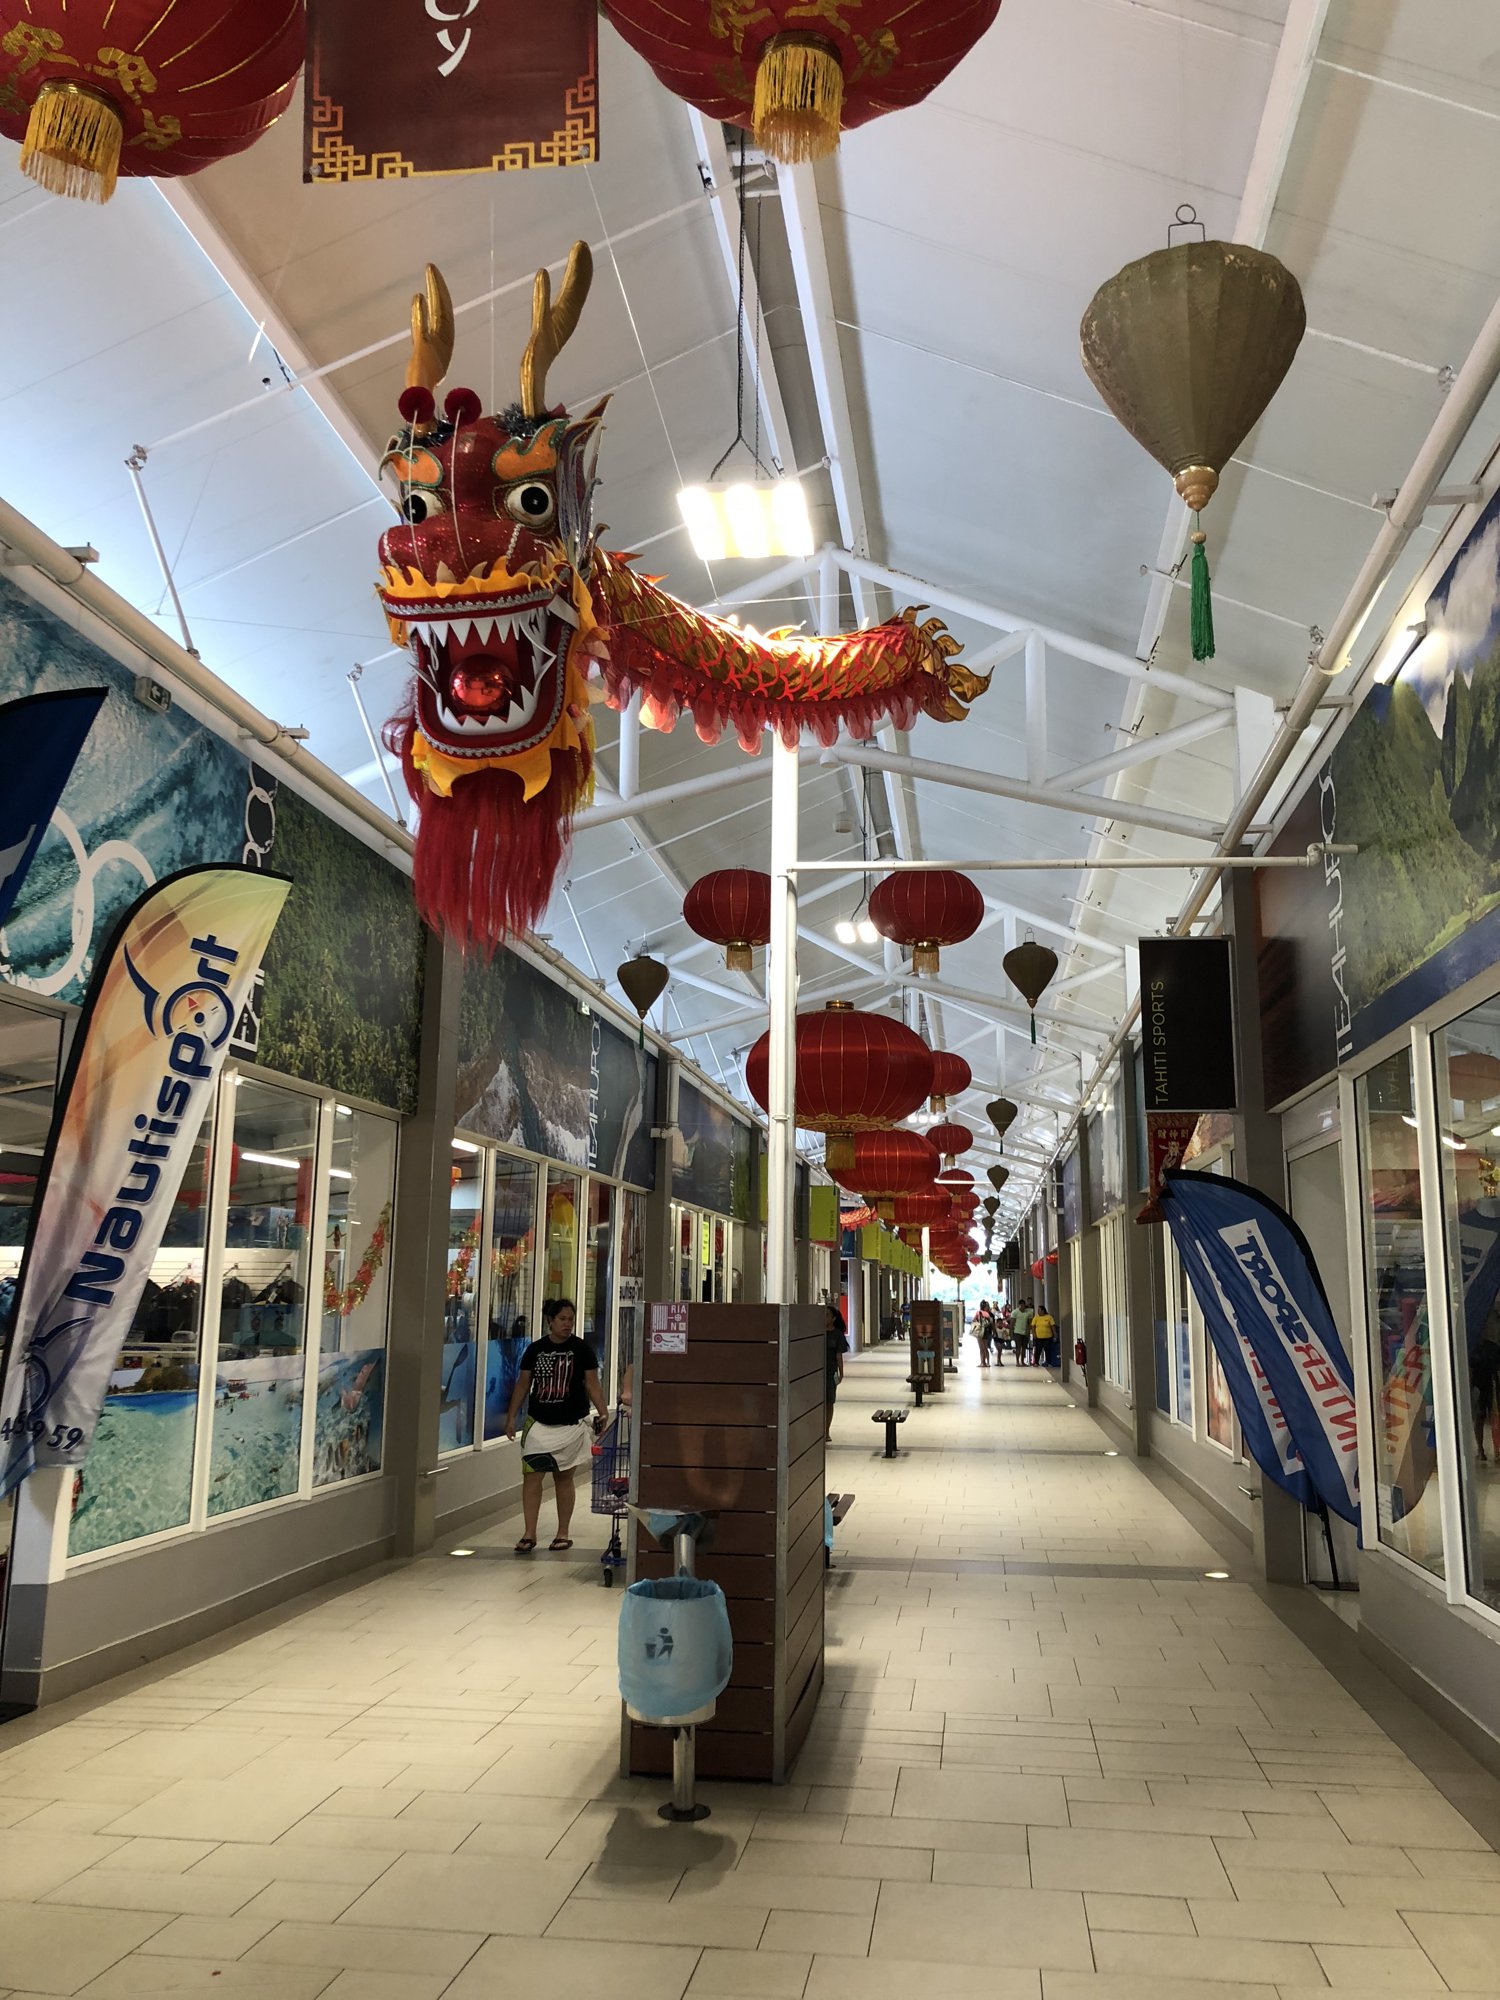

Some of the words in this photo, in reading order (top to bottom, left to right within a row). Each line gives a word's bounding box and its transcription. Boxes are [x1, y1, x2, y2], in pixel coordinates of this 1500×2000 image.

[1318, 752, 1353, 1067] TEAHUPO
[1151, 981, 1167, 1046] SPORTS
[1153, 1053, 1168, 1104] TAHITI
[65, 934, 239, 1306] Nautisport
